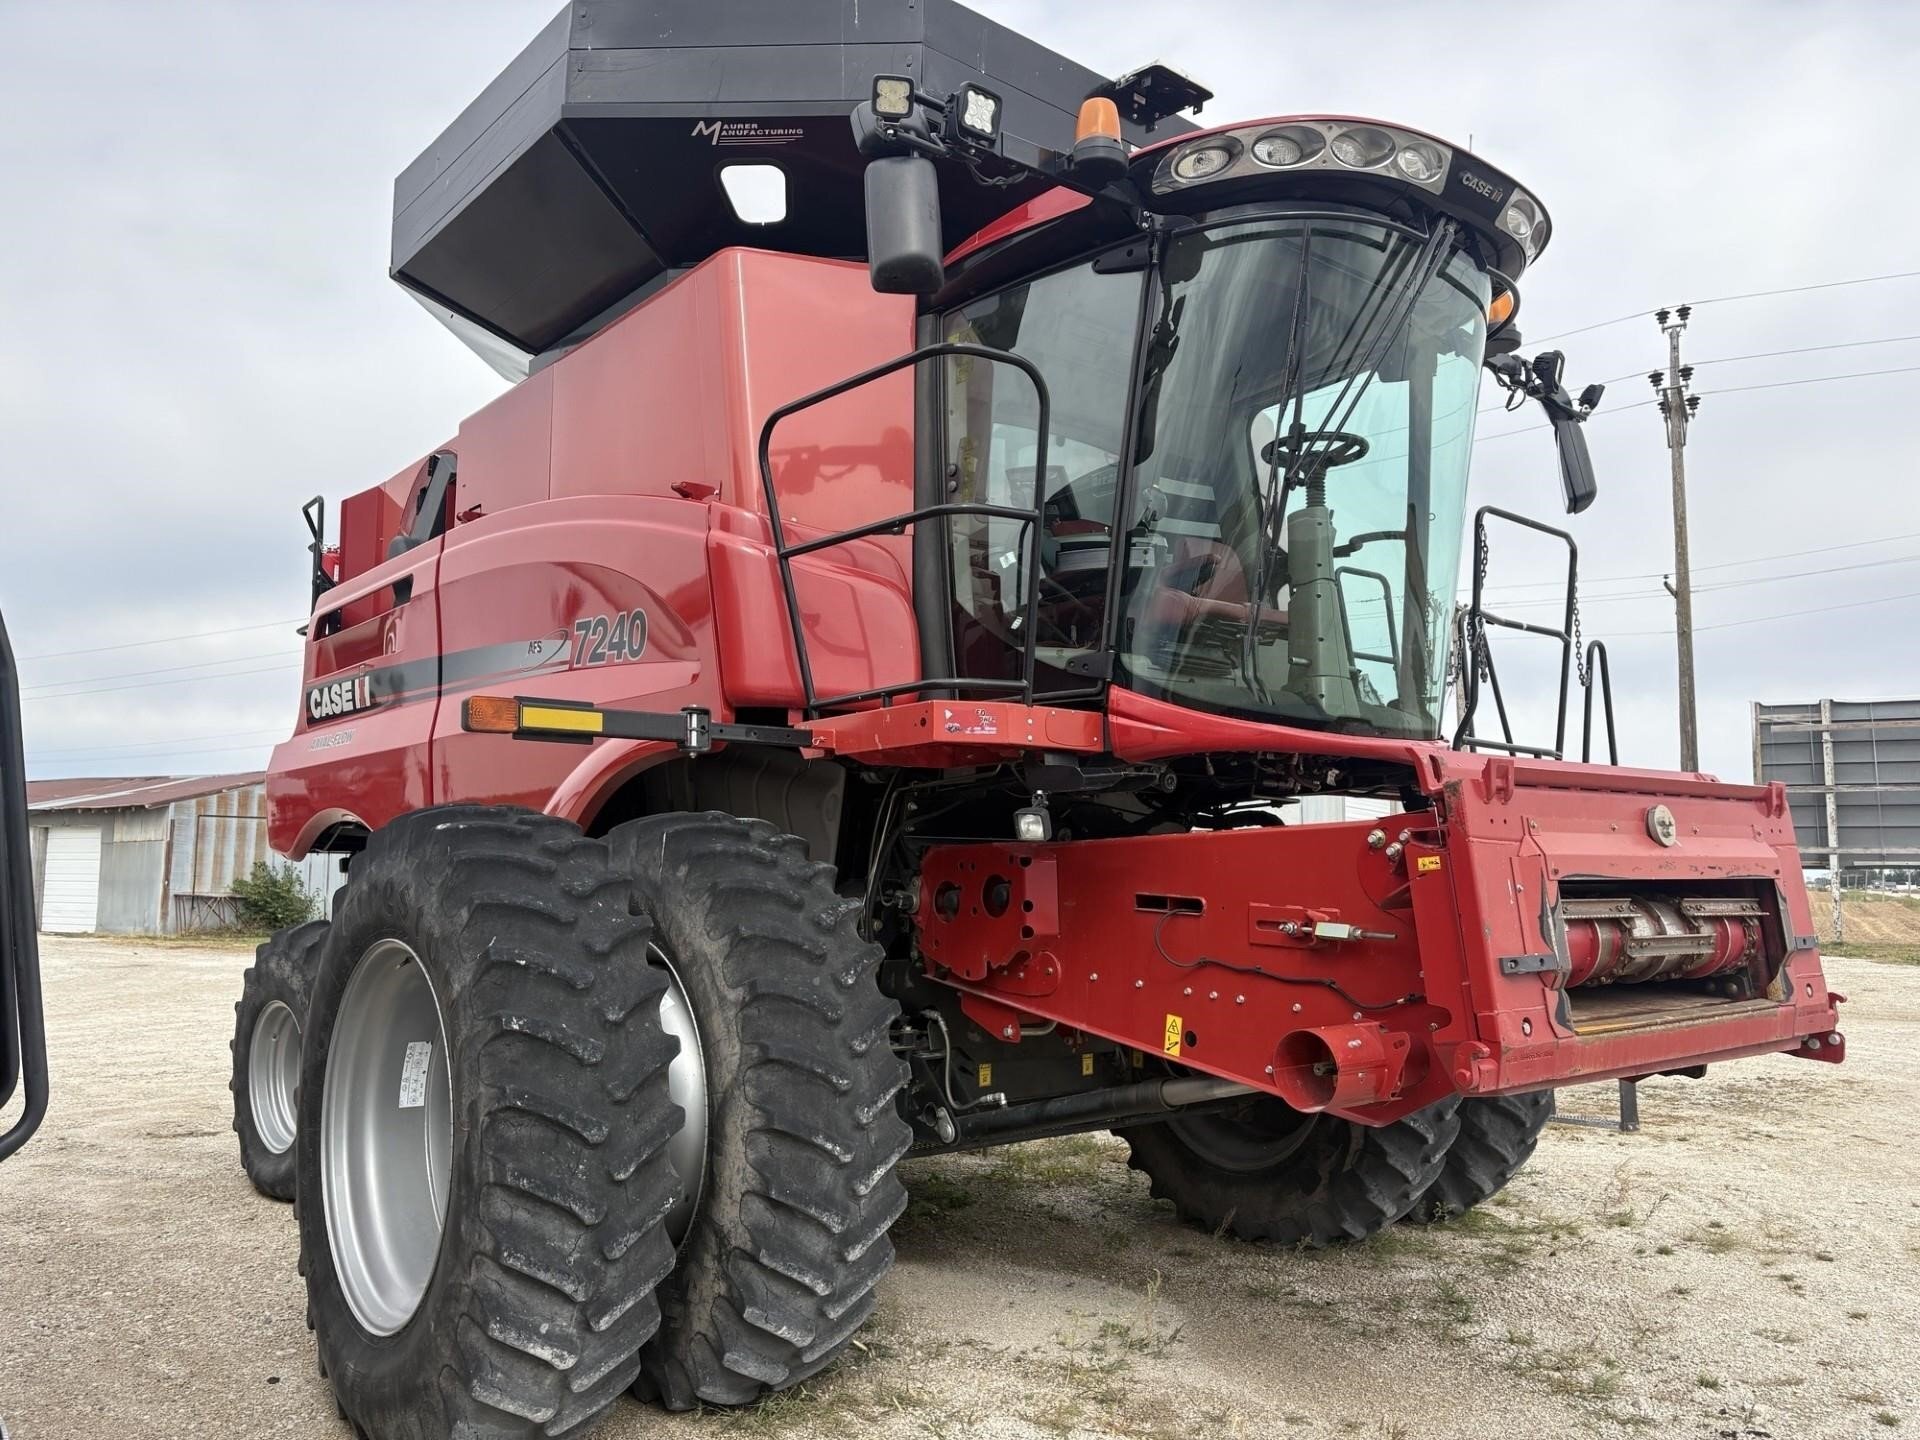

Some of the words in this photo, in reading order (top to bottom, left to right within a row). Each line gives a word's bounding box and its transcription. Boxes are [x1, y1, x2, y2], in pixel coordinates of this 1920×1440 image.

[1462, 172, 1493, 197] CASE
[527, 640, 543, 655] AFS
[573, 608, 648, 668] 7240
[310, 680, 354, 719] CASE
